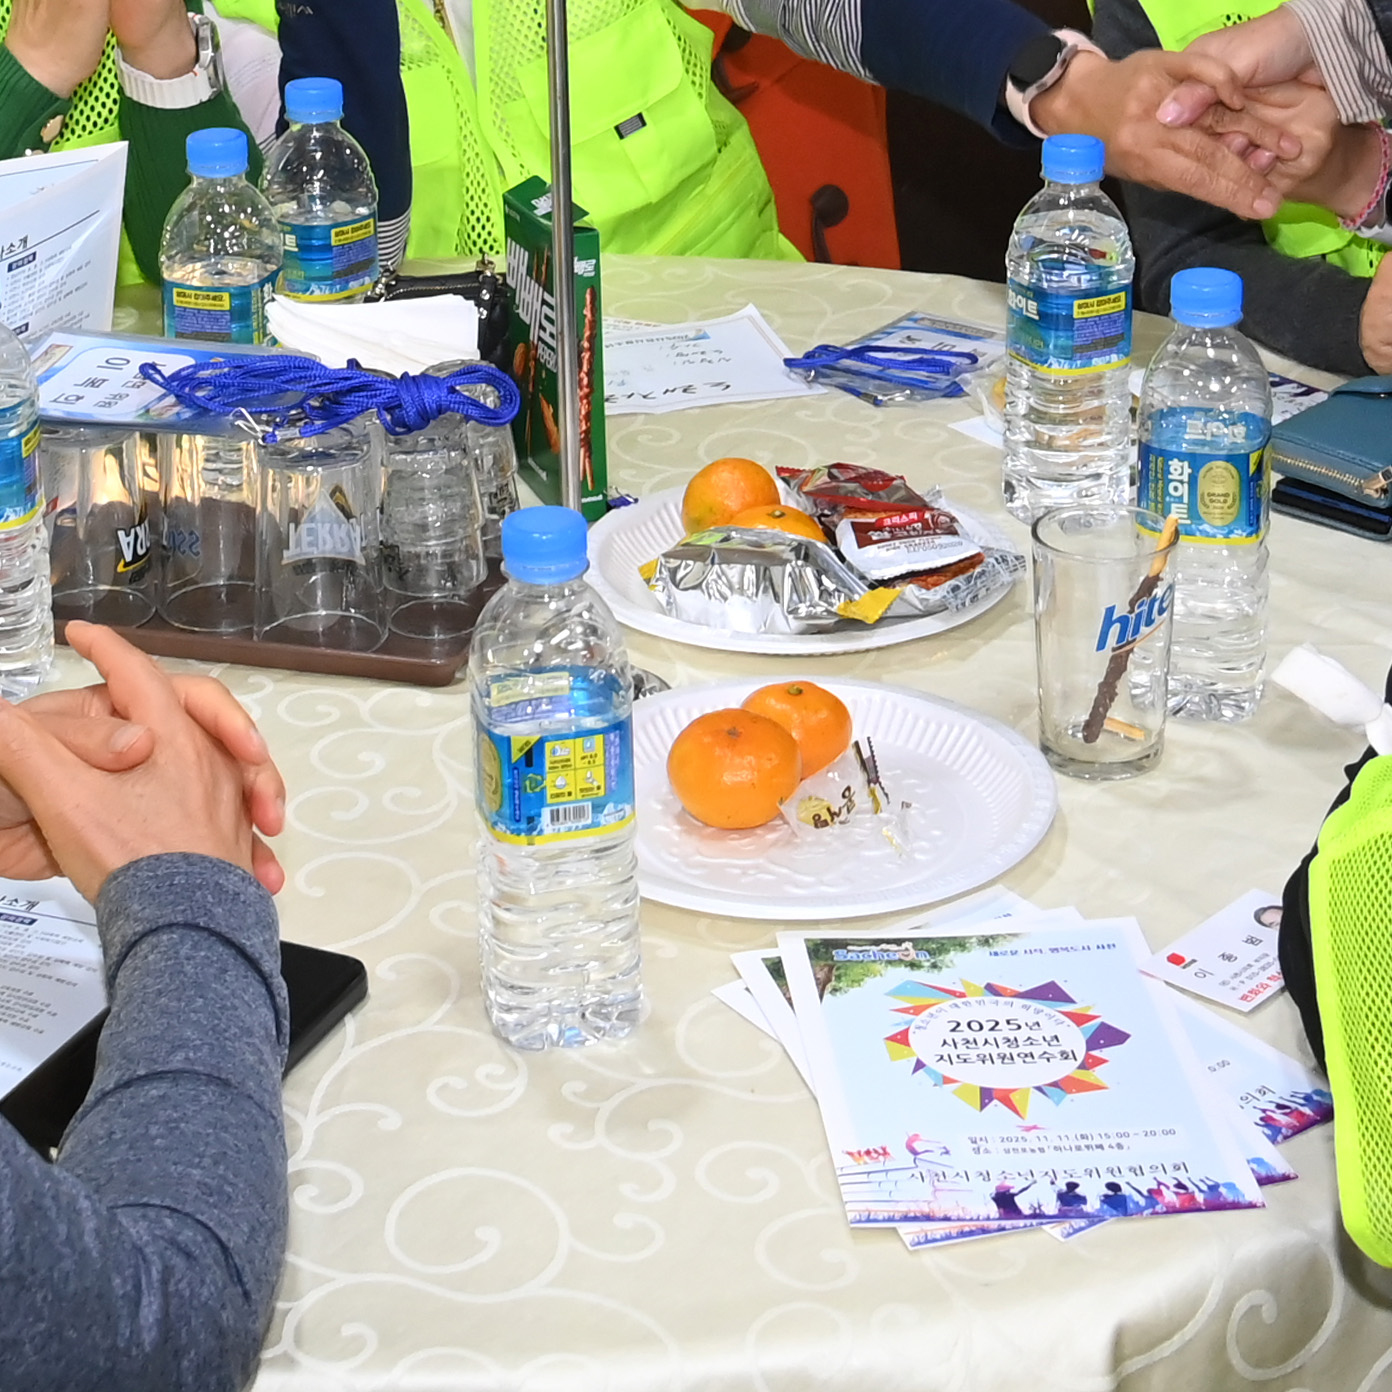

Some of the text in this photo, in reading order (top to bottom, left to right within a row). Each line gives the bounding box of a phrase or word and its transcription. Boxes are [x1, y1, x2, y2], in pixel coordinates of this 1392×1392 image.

[1095, 582, 1174, 653] hite
[947, 1017, 1043, 1034] 2025년
[940, 1034, 1063, 1051] 사천시청소년
[935, 1048, 1079, 1067] 지도위원연수회
